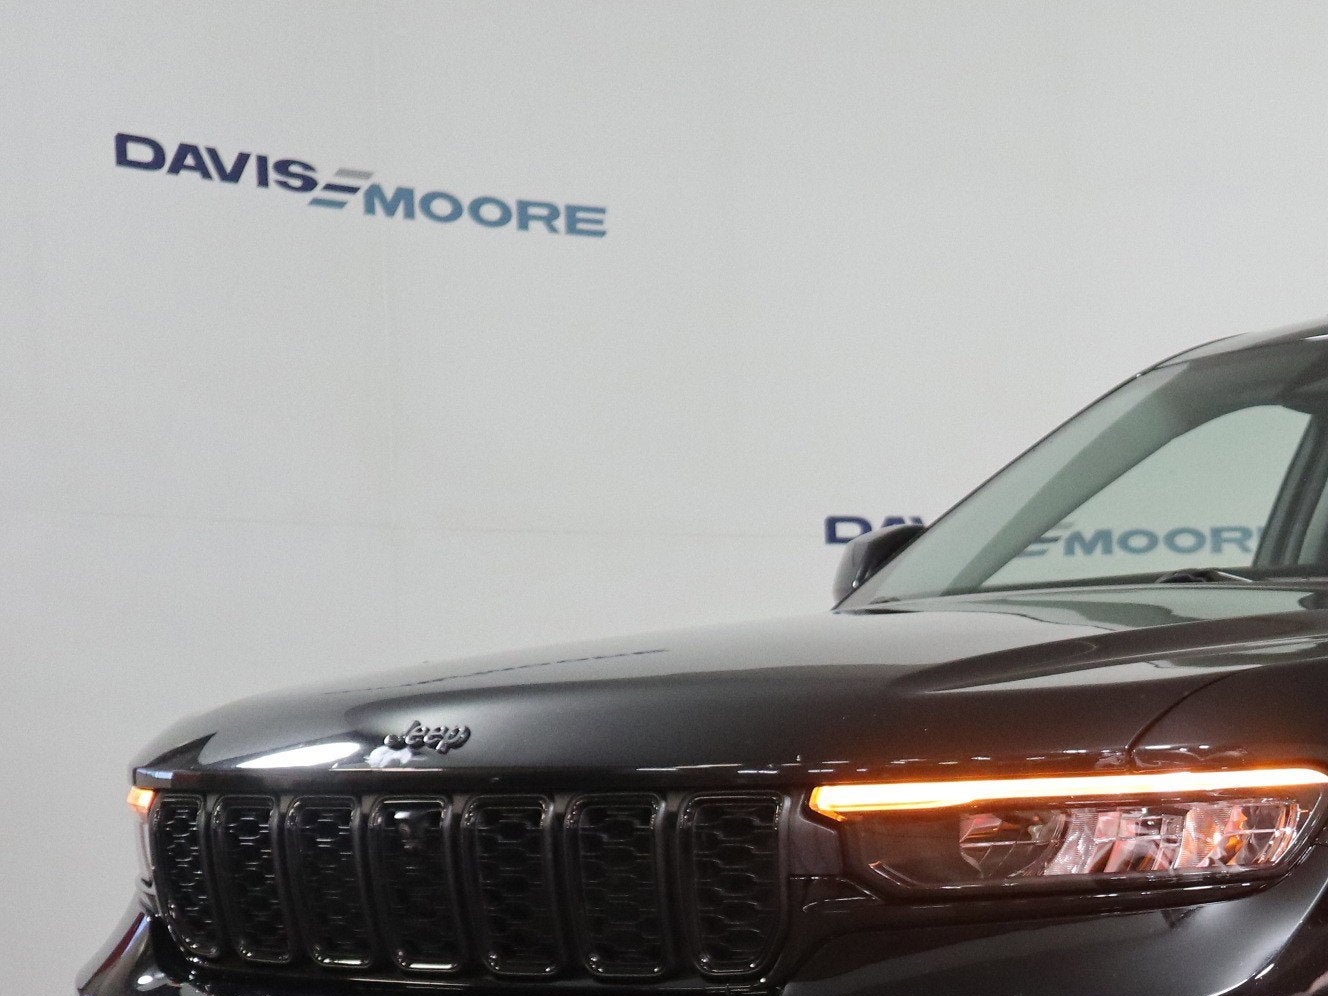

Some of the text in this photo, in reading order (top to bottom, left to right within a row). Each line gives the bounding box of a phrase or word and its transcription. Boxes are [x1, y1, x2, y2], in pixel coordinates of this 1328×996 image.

[115, 132, 608, 238] DAVIS MOORE
[1063, 525, 1265, 556] MOOR
[384, 719, 471, 755] Jeep
